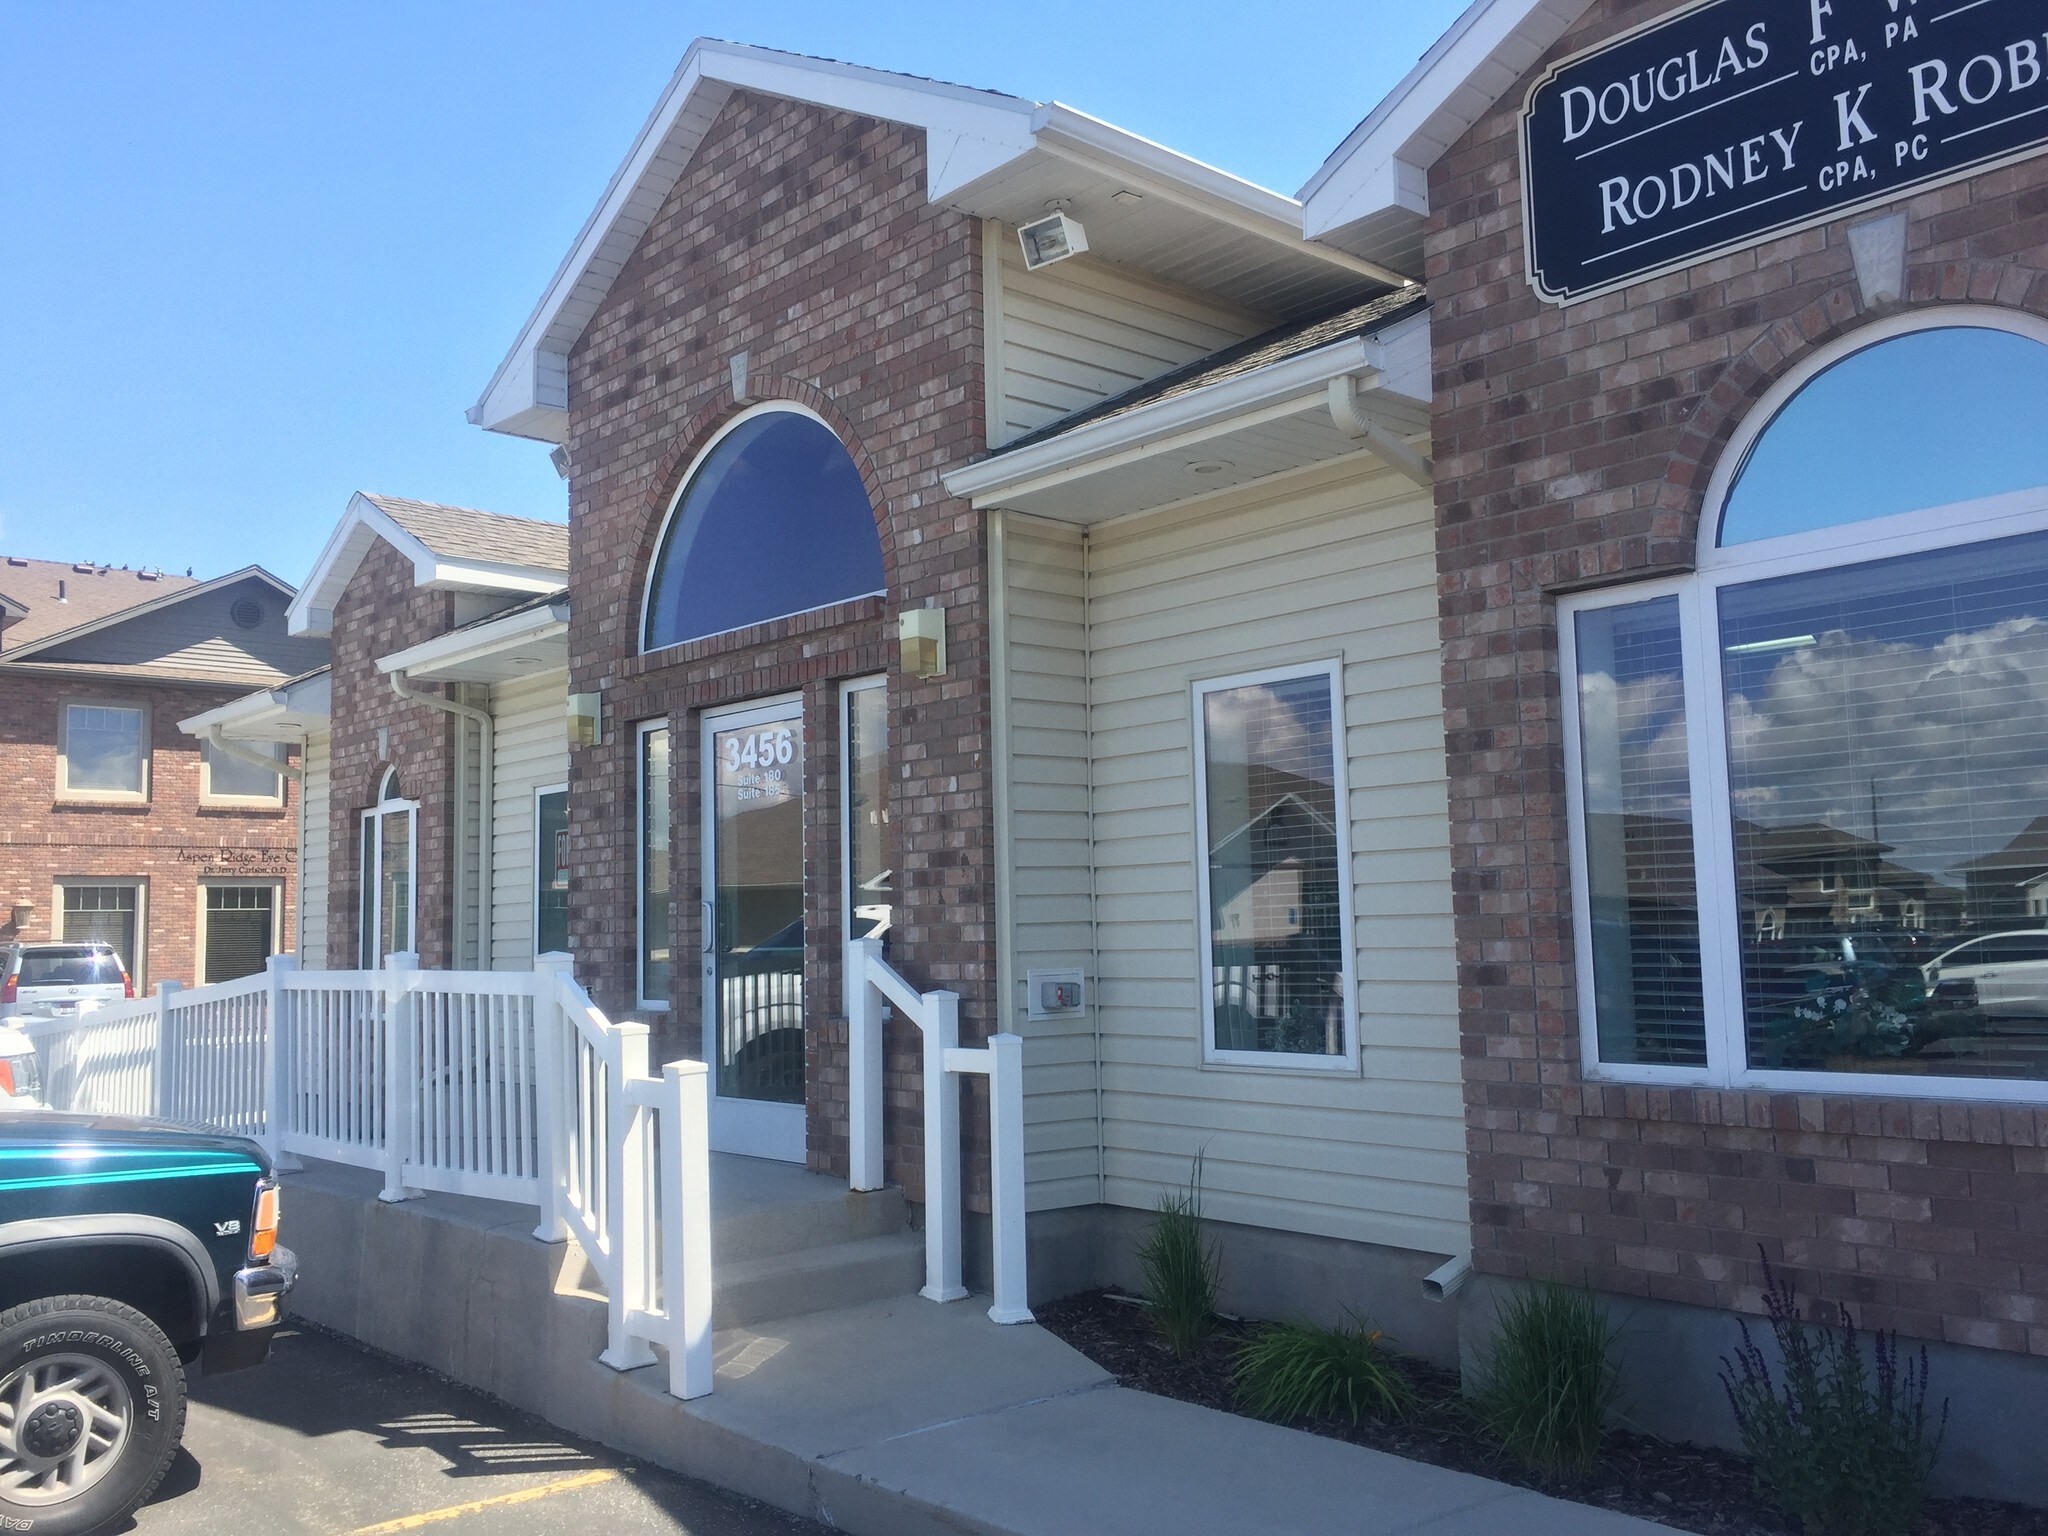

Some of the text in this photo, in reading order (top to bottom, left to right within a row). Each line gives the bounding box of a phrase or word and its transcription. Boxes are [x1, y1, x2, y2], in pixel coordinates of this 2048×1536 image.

[1809, 15, 1919, 77] CPA, PA
[1560, 22, 1769, 144] DOUGLAS
[1599, 31, 2048, 235] RODNEY K ROB
[1818, 133, 1929, 192] CPA, PC
[725, 728, 793, 772] 3456
[738, 769, 781, 786] Suite 180
[738, 784, 780, 800] Suite 185
[176, 847, 215, 865] Aspen
[220, 848, 257, 867] Ridge
[261, 849, 280, 865] Eye
[217, 866, 237, 875] Jerry
[23, 1330, 160, 1422] TIMBERLINE A/T
